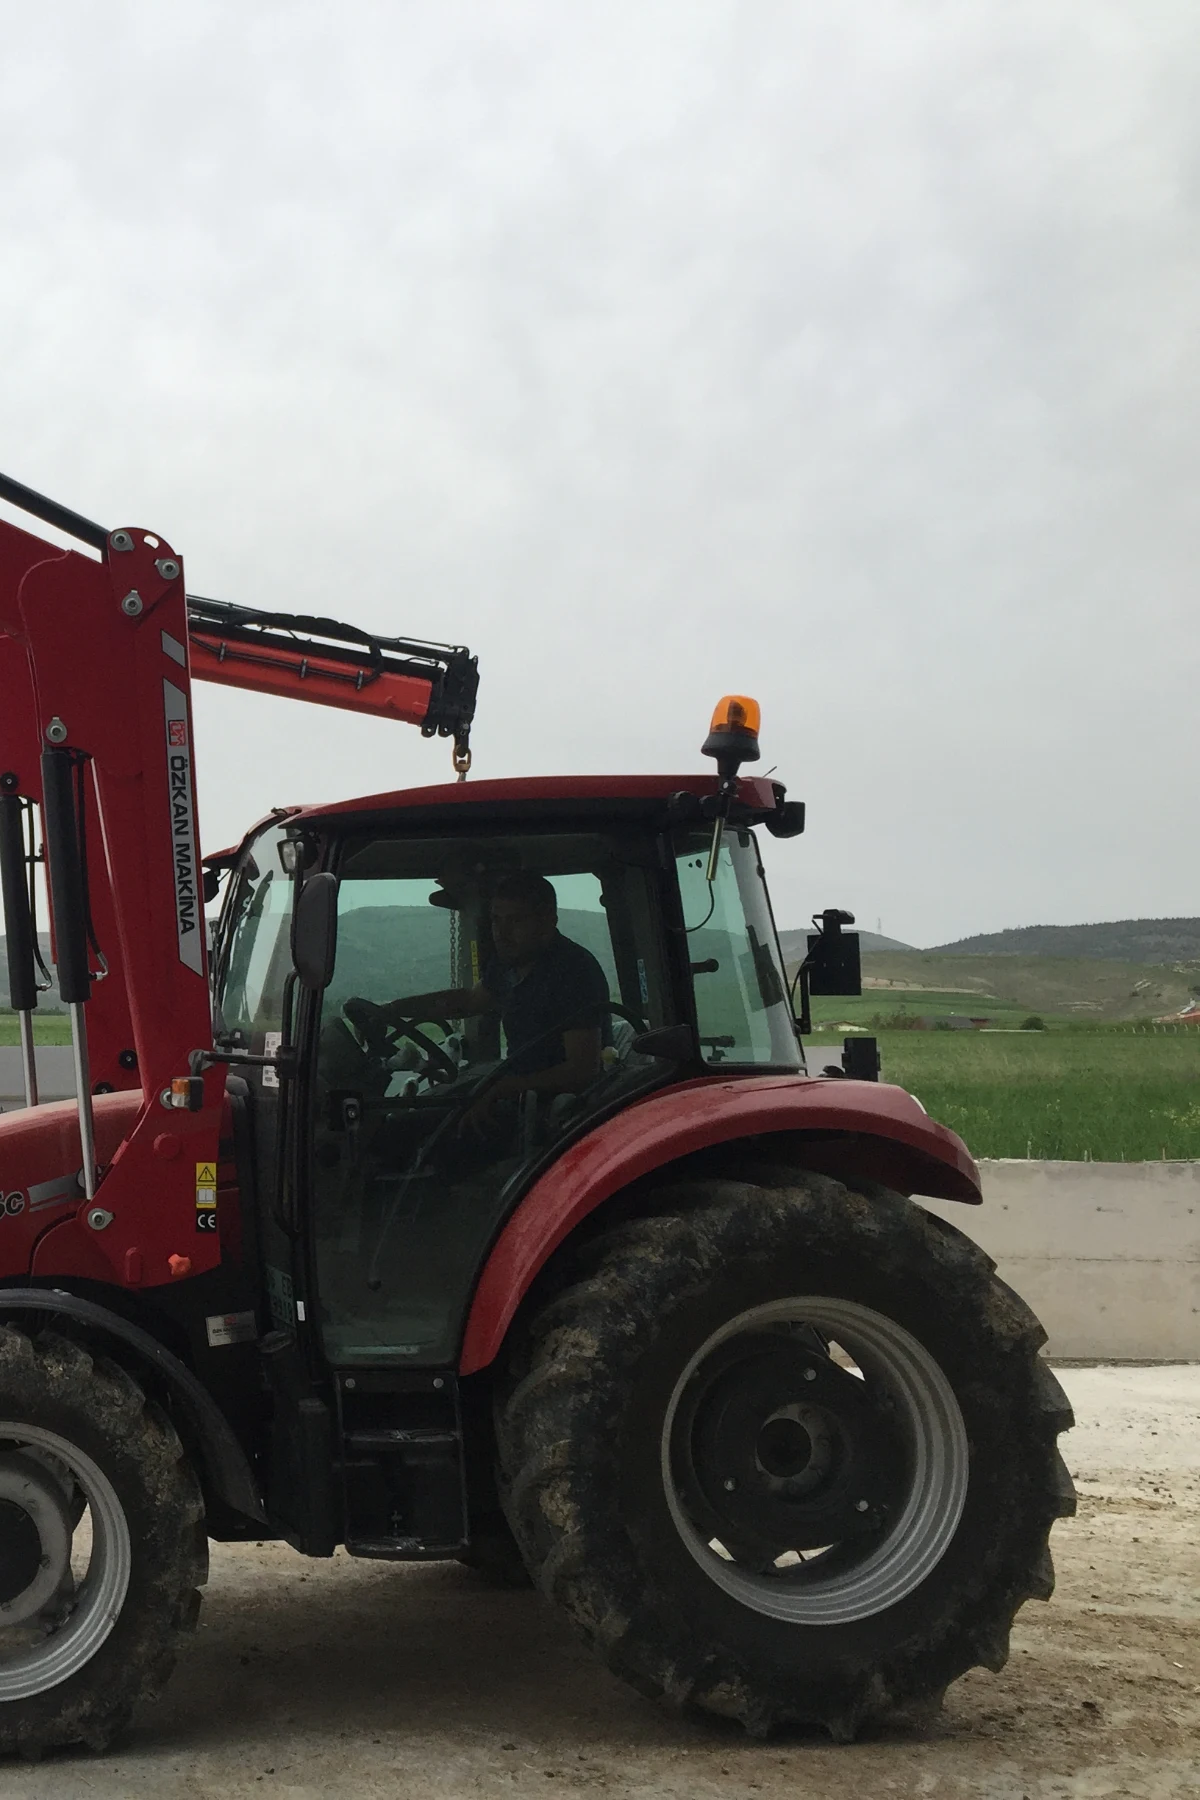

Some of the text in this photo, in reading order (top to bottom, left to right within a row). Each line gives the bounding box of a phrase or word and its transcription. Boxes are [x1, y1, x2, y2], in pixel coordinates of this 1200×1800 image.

[170, 755, 195, 935] ÖZKAN MAKİNA
[197, 1214, 215, 1228] CE
